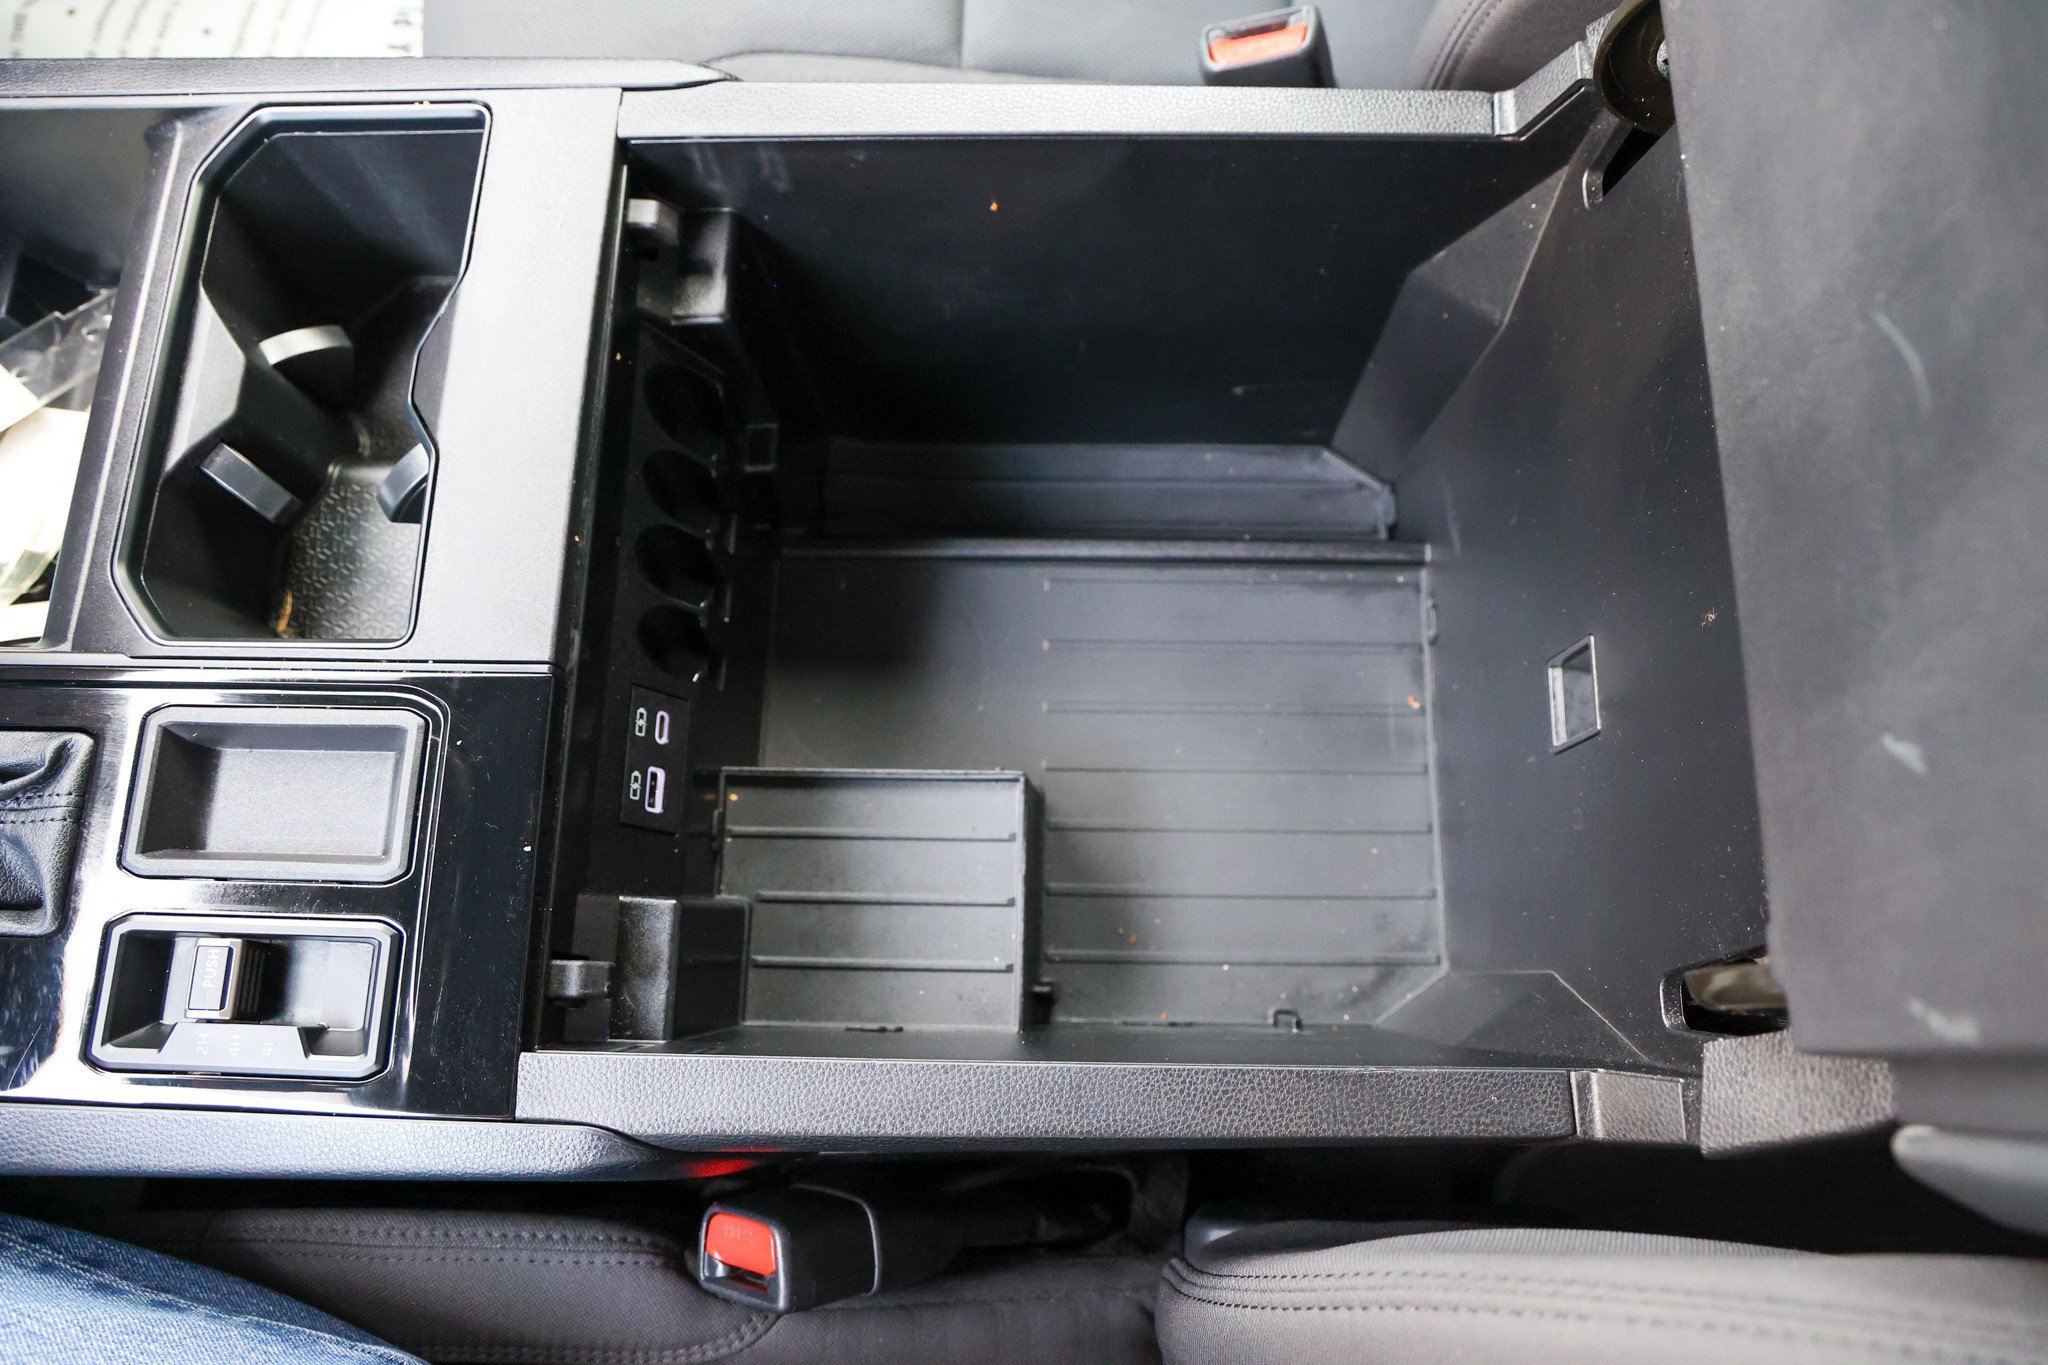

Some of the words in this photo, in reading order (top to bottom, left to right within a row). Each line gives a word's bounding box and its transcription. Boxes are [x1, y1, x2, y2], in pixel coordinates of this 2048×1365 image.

[203, 949, 219, 987] PUSH
[196, 1033, 210, 1055] 2H
[229, 1035, 242, 1057] 4H
[262, 1037, 275, 1057] 4L
